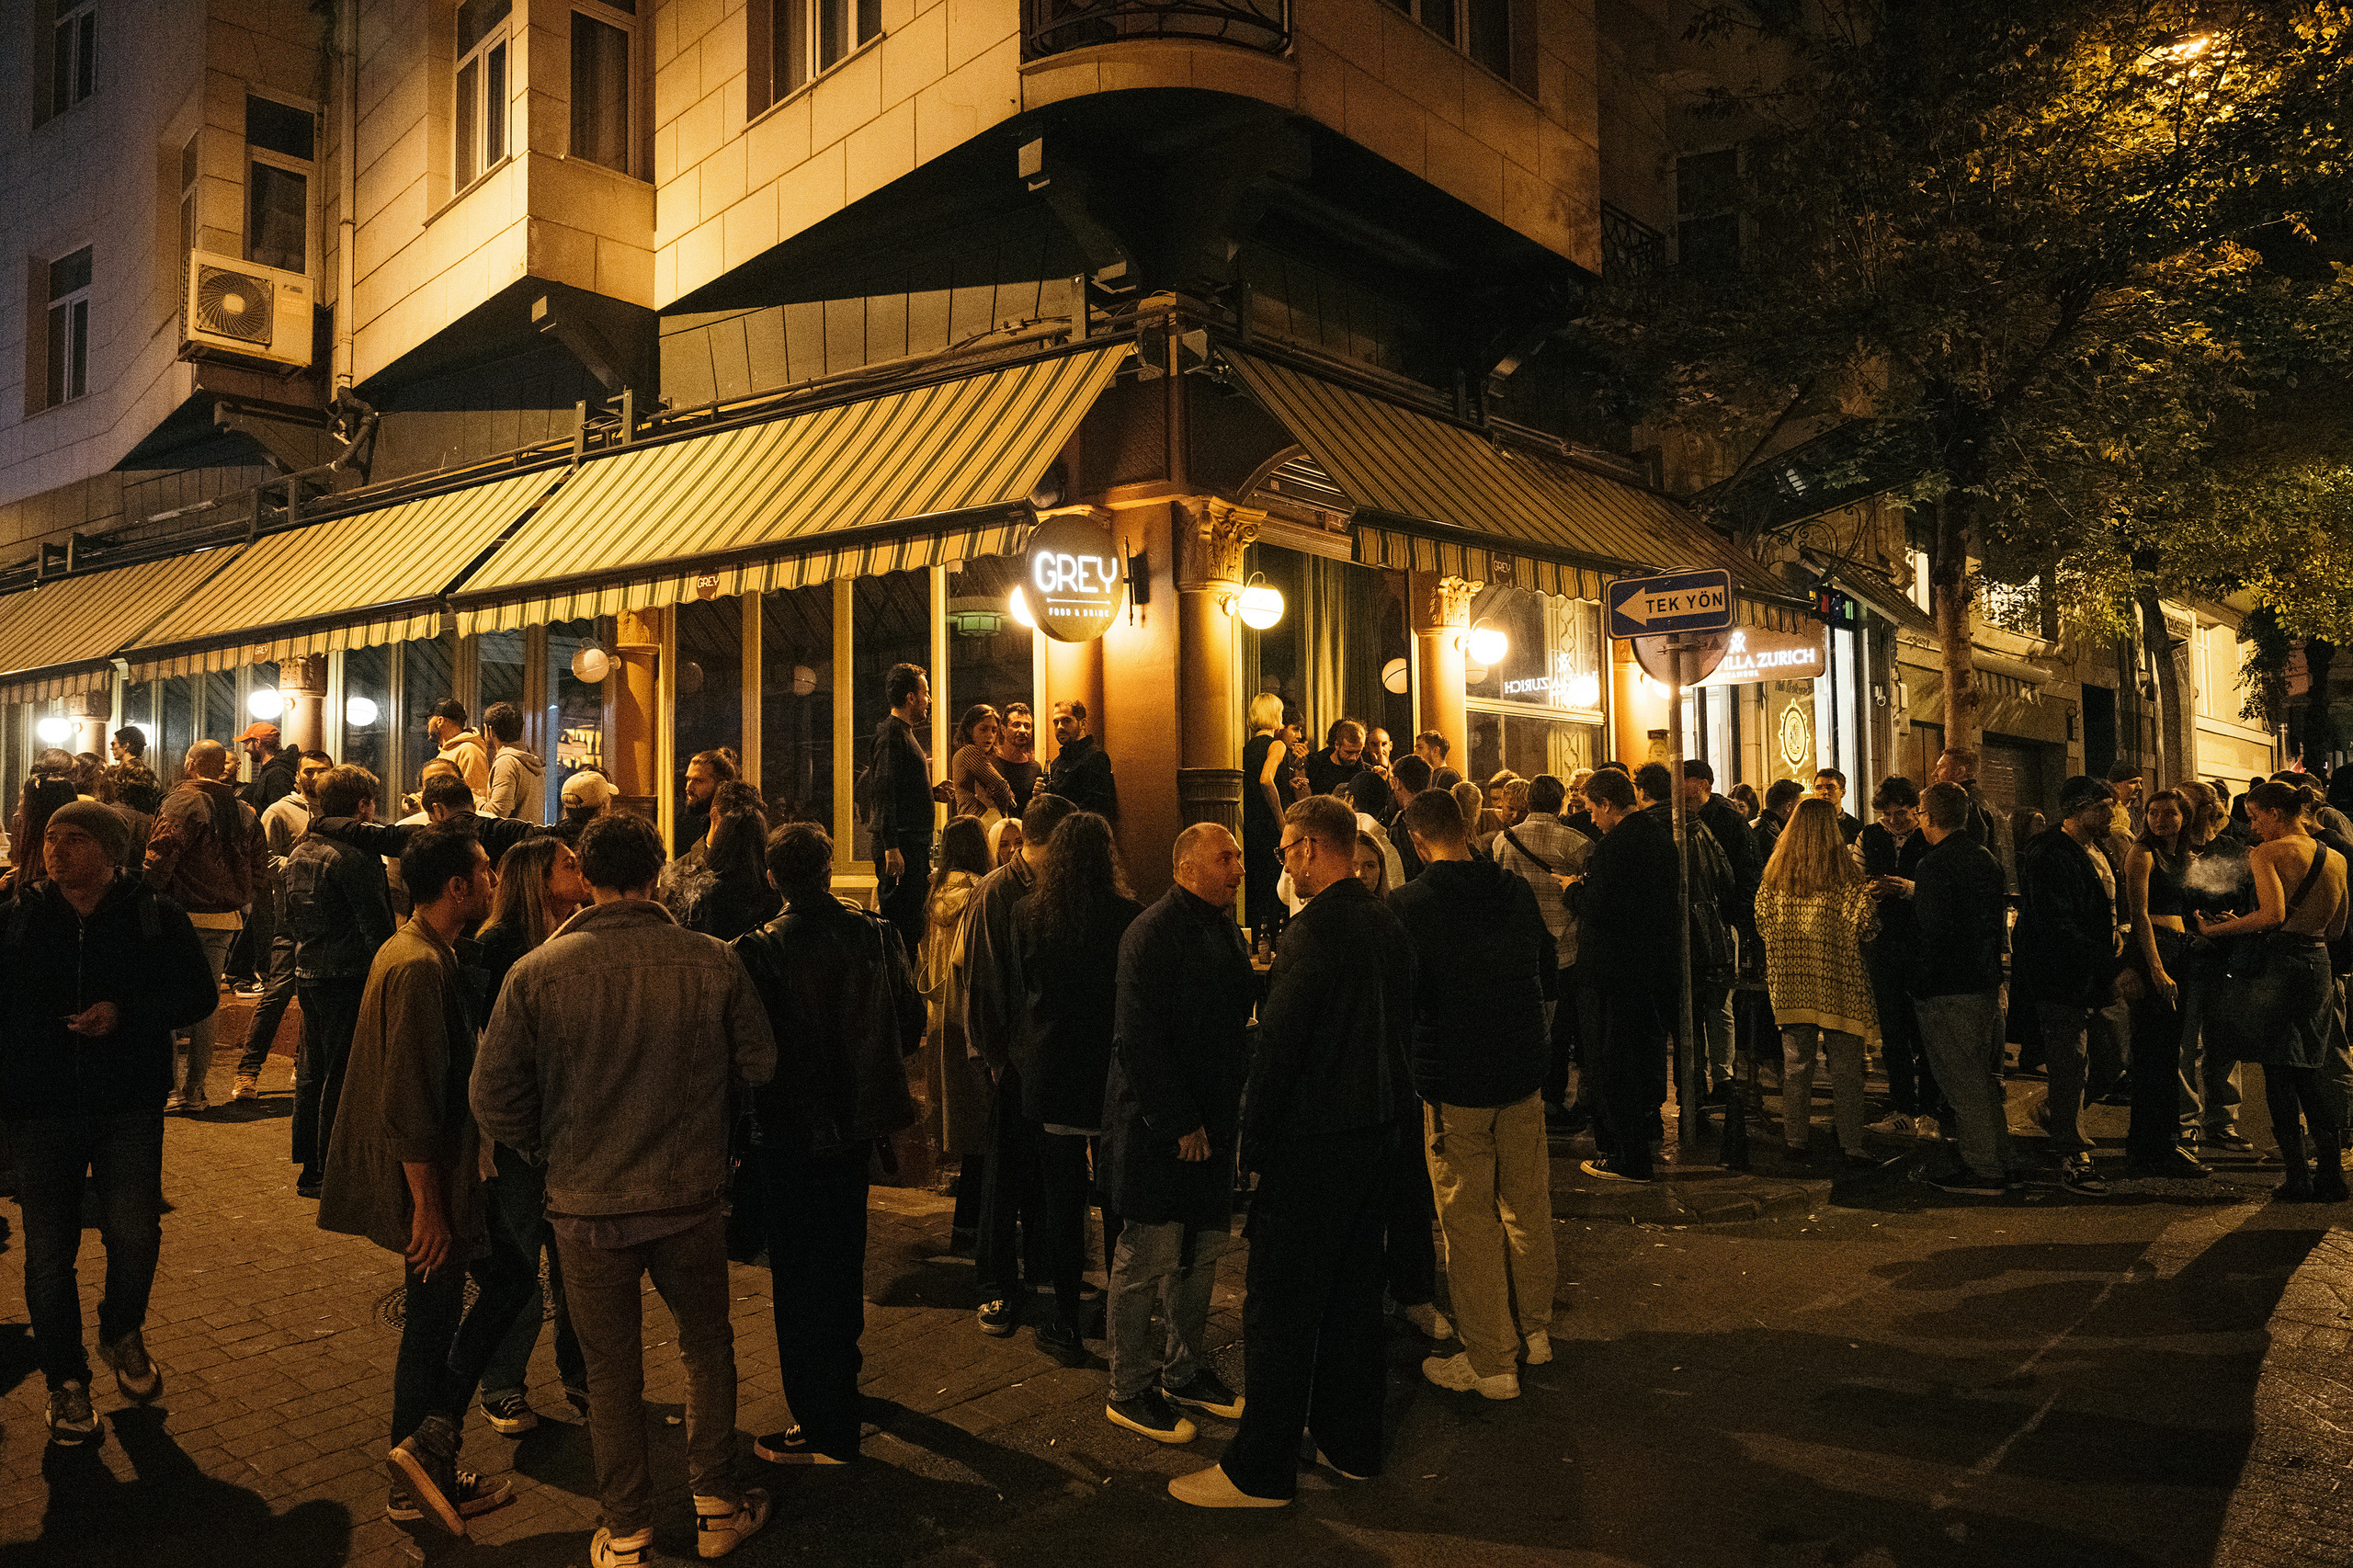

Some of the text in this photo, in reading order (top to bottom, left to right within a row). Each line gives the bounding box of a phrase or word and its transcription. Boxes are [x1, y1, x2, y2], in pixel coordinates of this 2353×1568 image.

[1035, 551, 1118, 594] GREY
[1493, 560, 1511, 573] GREY
[698, 575, 720, 588] GREY
[1645, 590, 1722, 613] TEK YÖN
[1049, 608, 1071, 617] FOOD
[1083, 608, 1109, 617] DRINK
[256, 645, 268, 654] GREY
[1756, 647, 1815, 668] ZURICH
